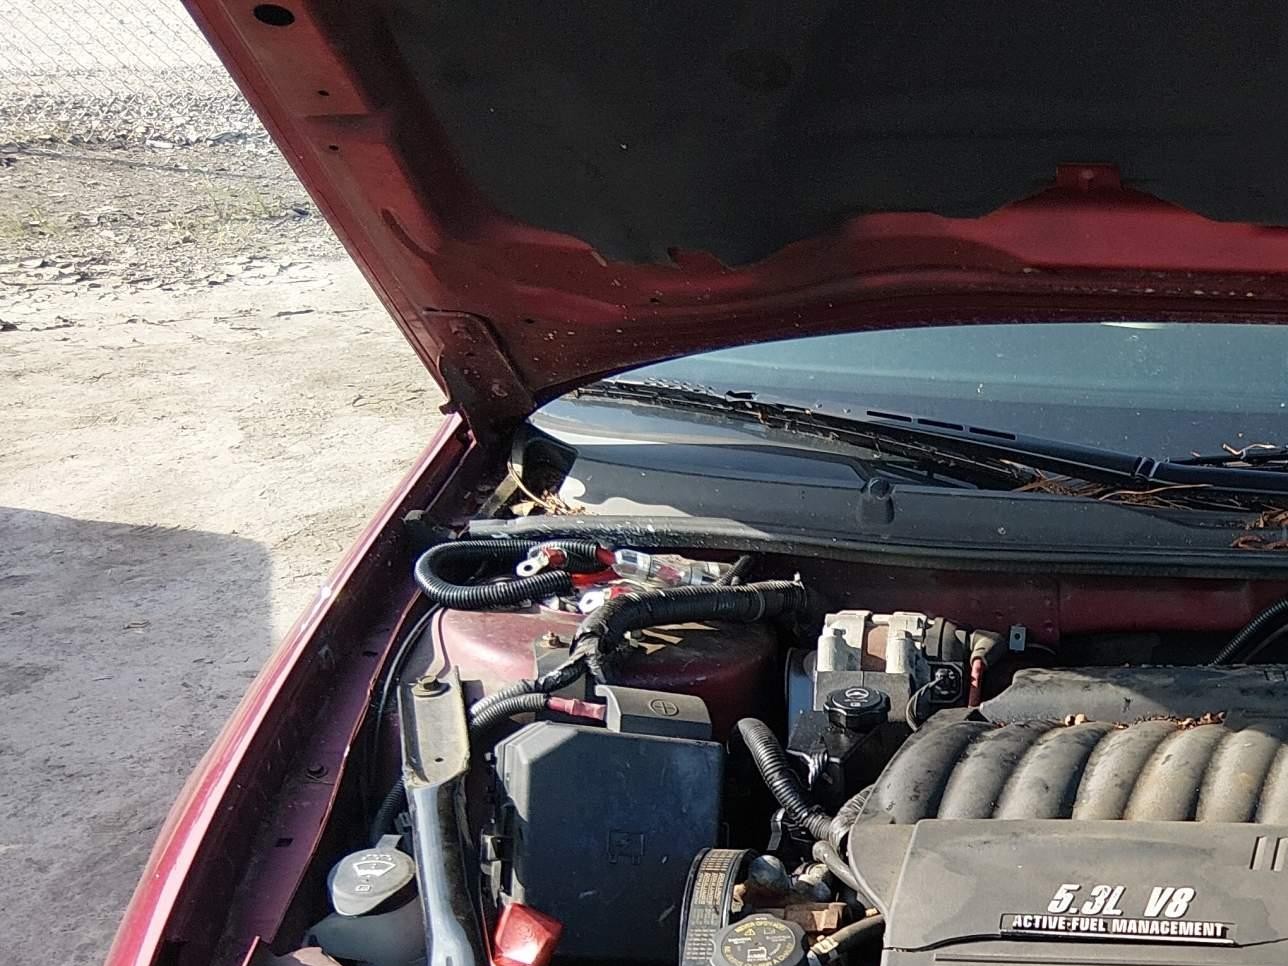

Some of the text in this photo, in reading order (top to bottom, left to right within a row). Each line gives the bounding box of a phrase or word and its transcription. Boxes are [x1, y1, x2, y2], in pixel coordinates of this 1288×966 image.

[1048, 884, 1194, 918] 5.3L V8
[1012, 915, 1224, 937] ACTIVE FUEL MANAGEMENT
